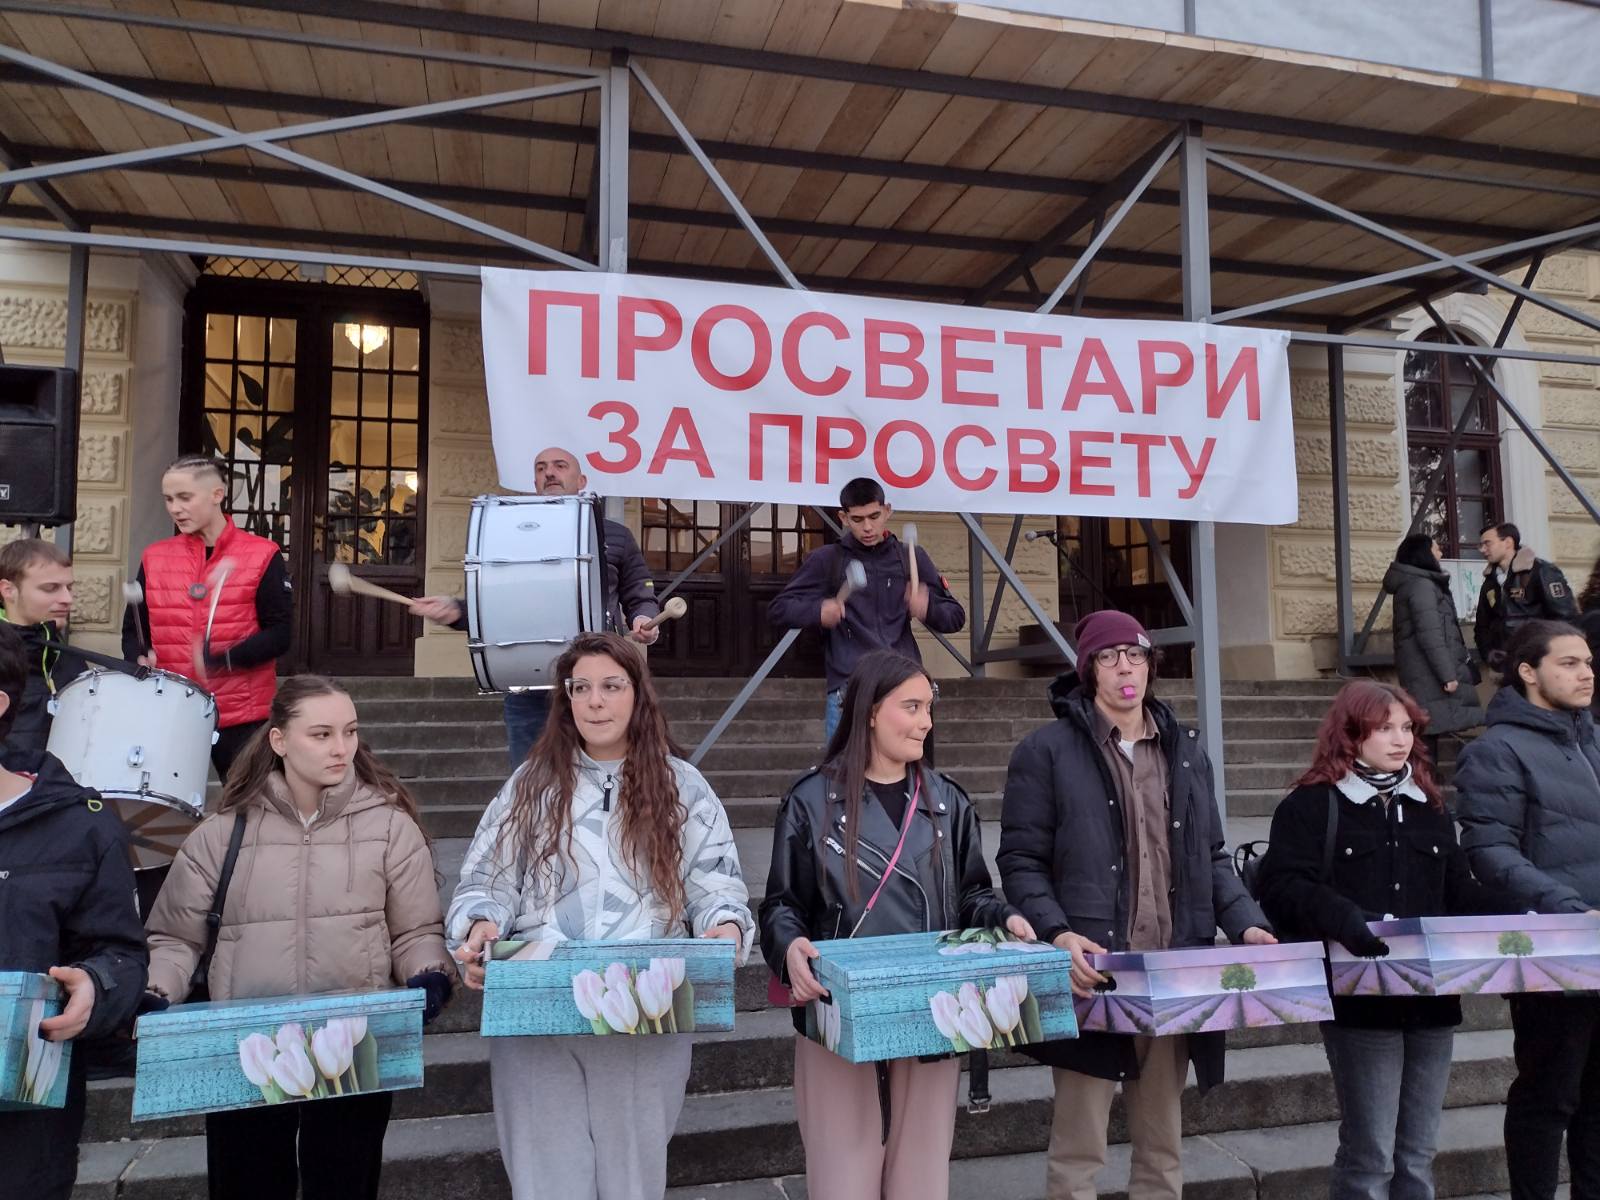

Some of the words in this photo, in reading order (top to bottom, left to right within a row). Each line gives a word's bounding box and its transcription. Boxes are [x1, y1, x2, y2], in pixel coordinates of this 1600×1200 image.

[527, 289, 1261, 421] ПРОСВЕТАРИ
[586, 400, 714, 479] ЗА
[748, 413, 1216, 500] ПРОСВЕТУ
